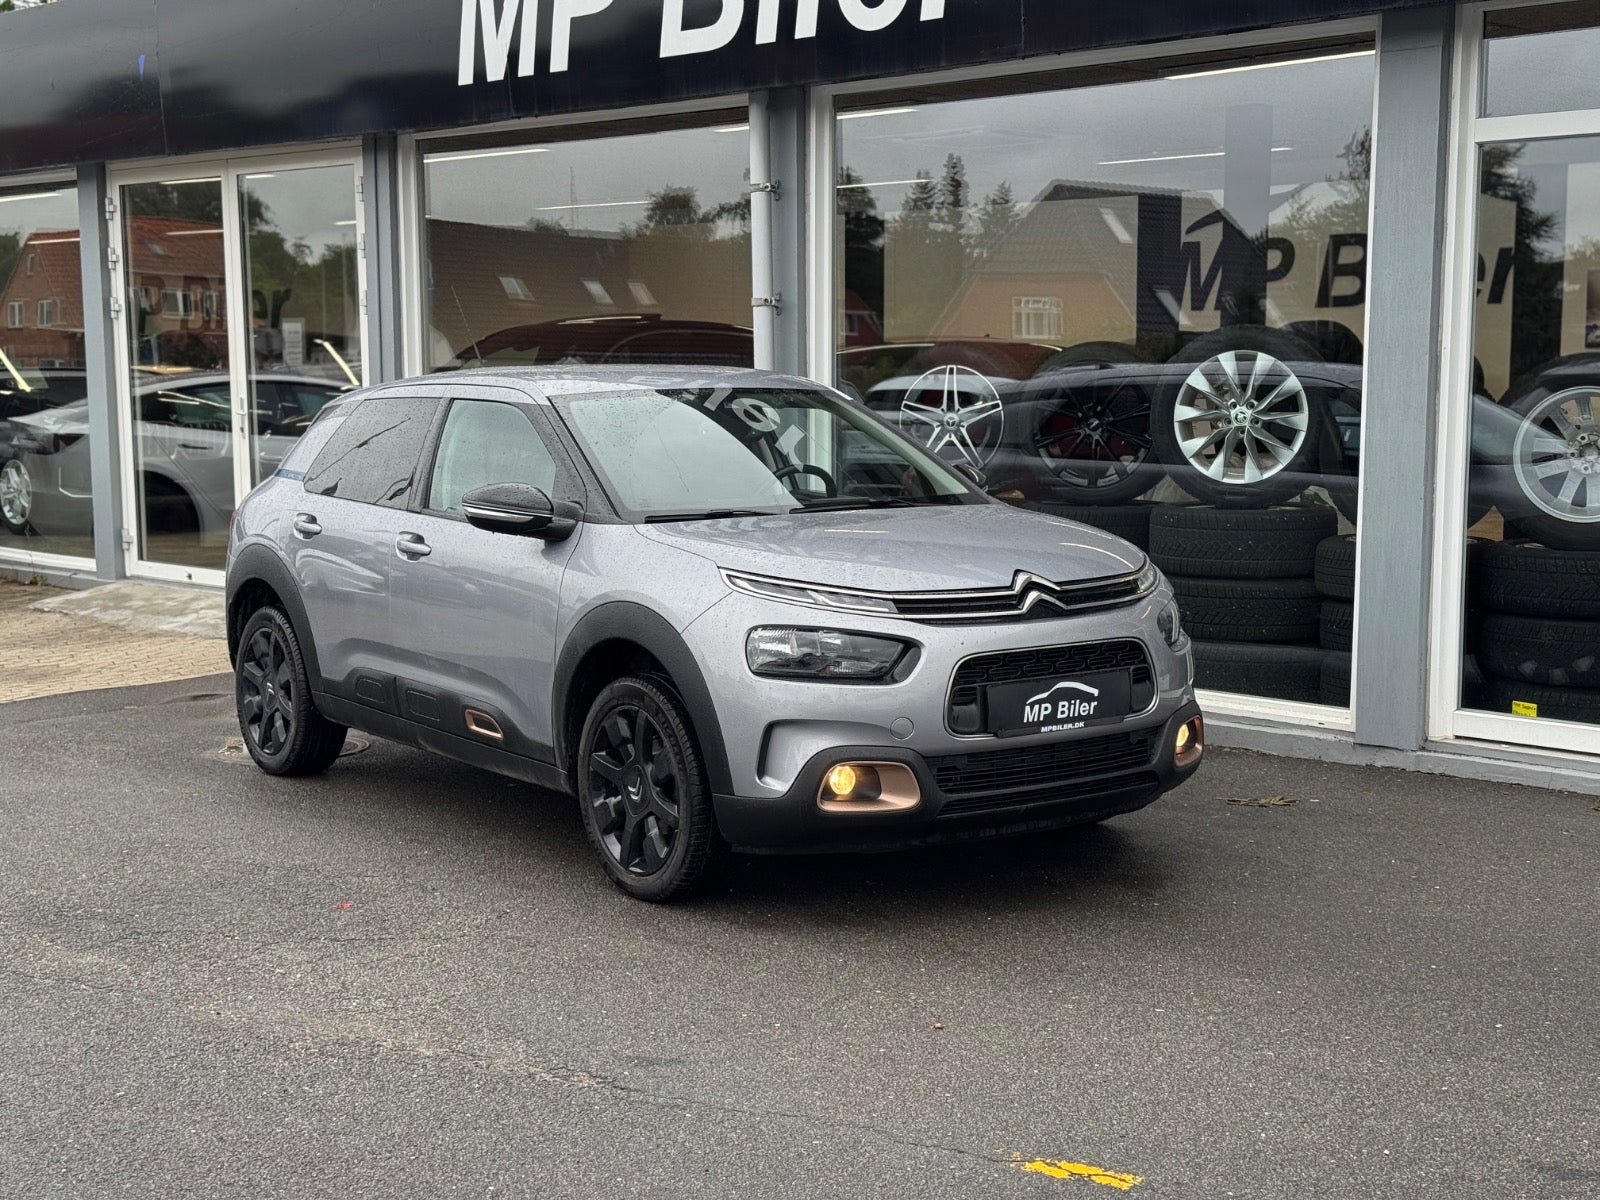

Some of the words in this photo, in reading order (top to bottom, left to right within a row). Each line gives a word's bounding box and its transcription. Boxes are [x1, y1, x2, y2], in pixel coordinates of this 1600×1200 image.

[1024, 703, 1051, 723] MP
[1058, 700, 1097, 719] Biler
[1041, 722, 1084, 732] MPBILER.DK
